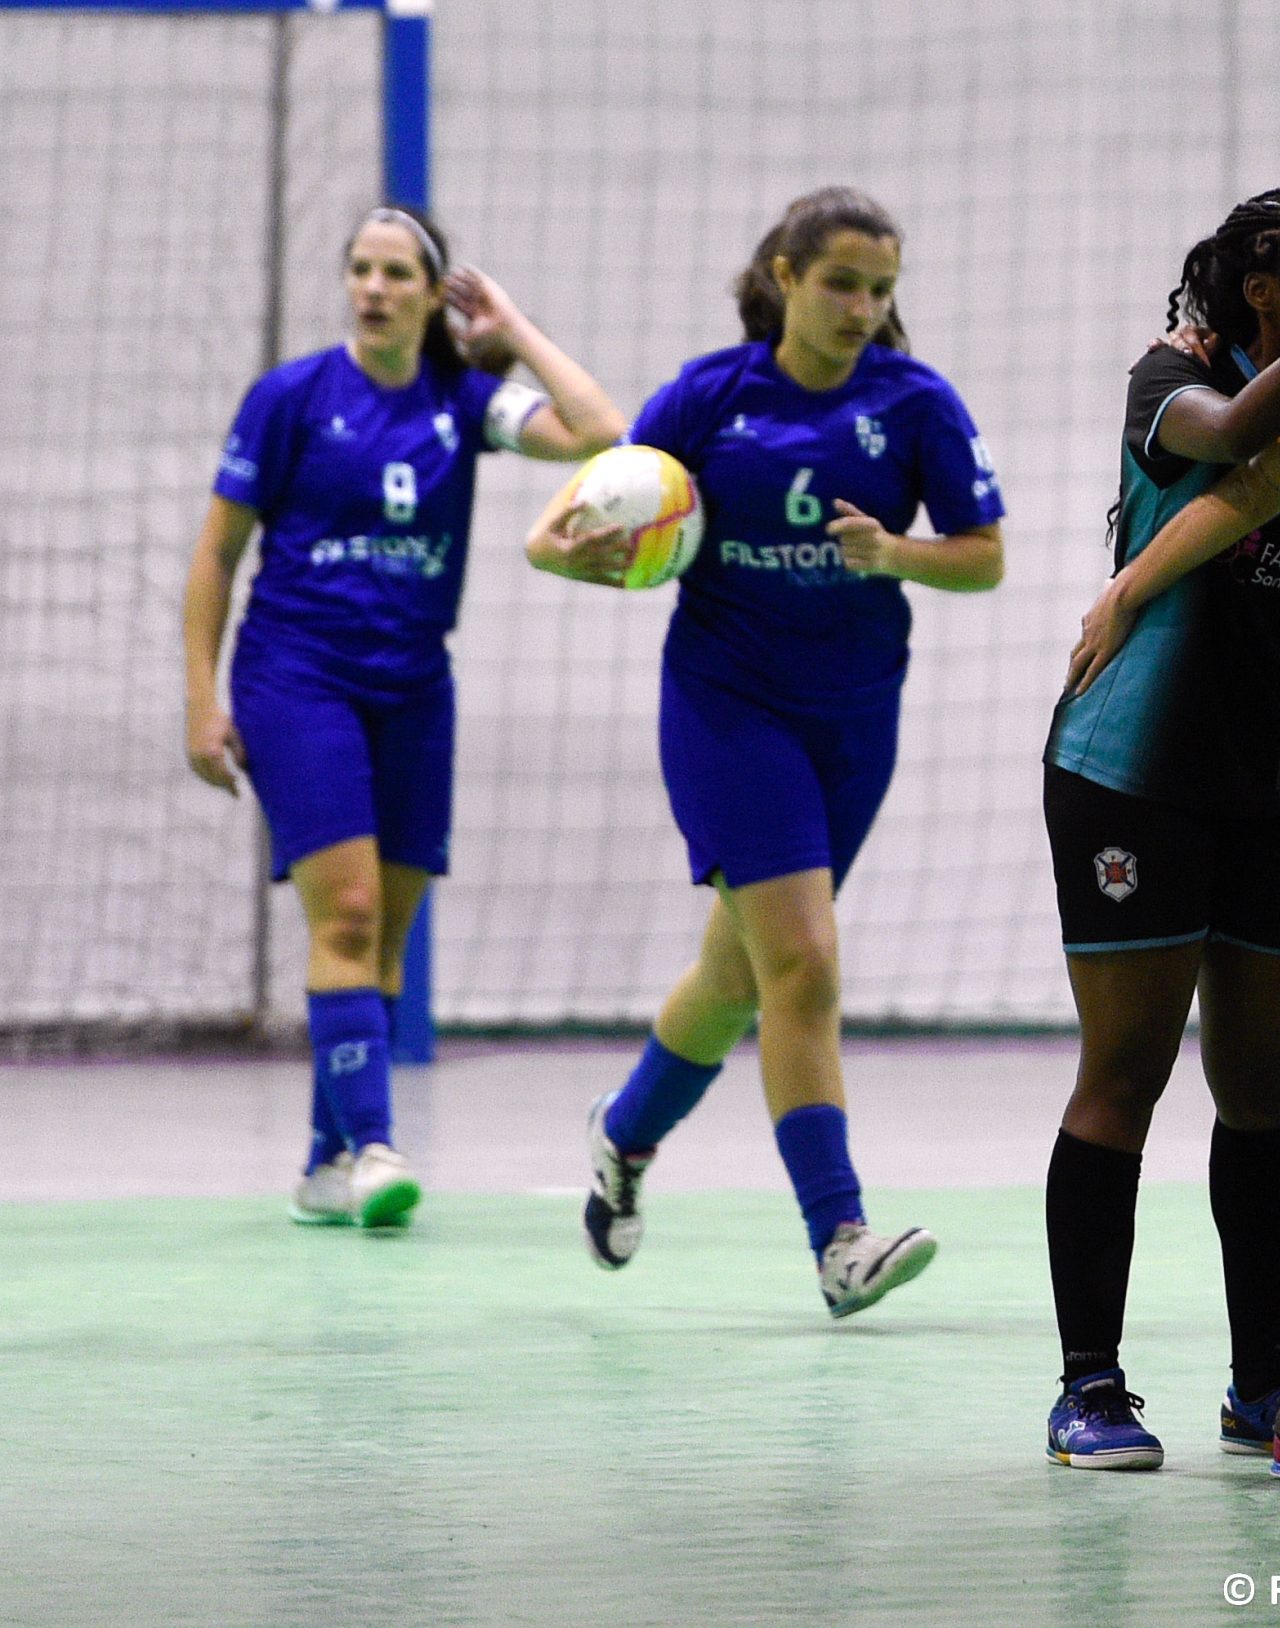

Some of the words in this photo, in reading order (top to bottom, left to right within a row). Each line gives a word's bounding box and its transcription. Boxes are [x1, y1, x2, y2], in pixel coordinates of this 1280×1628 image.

[382, 461, 419, 526] 8
[785, 466, 824, 527] 6
[719, 539, 842, 571] FILSTON
